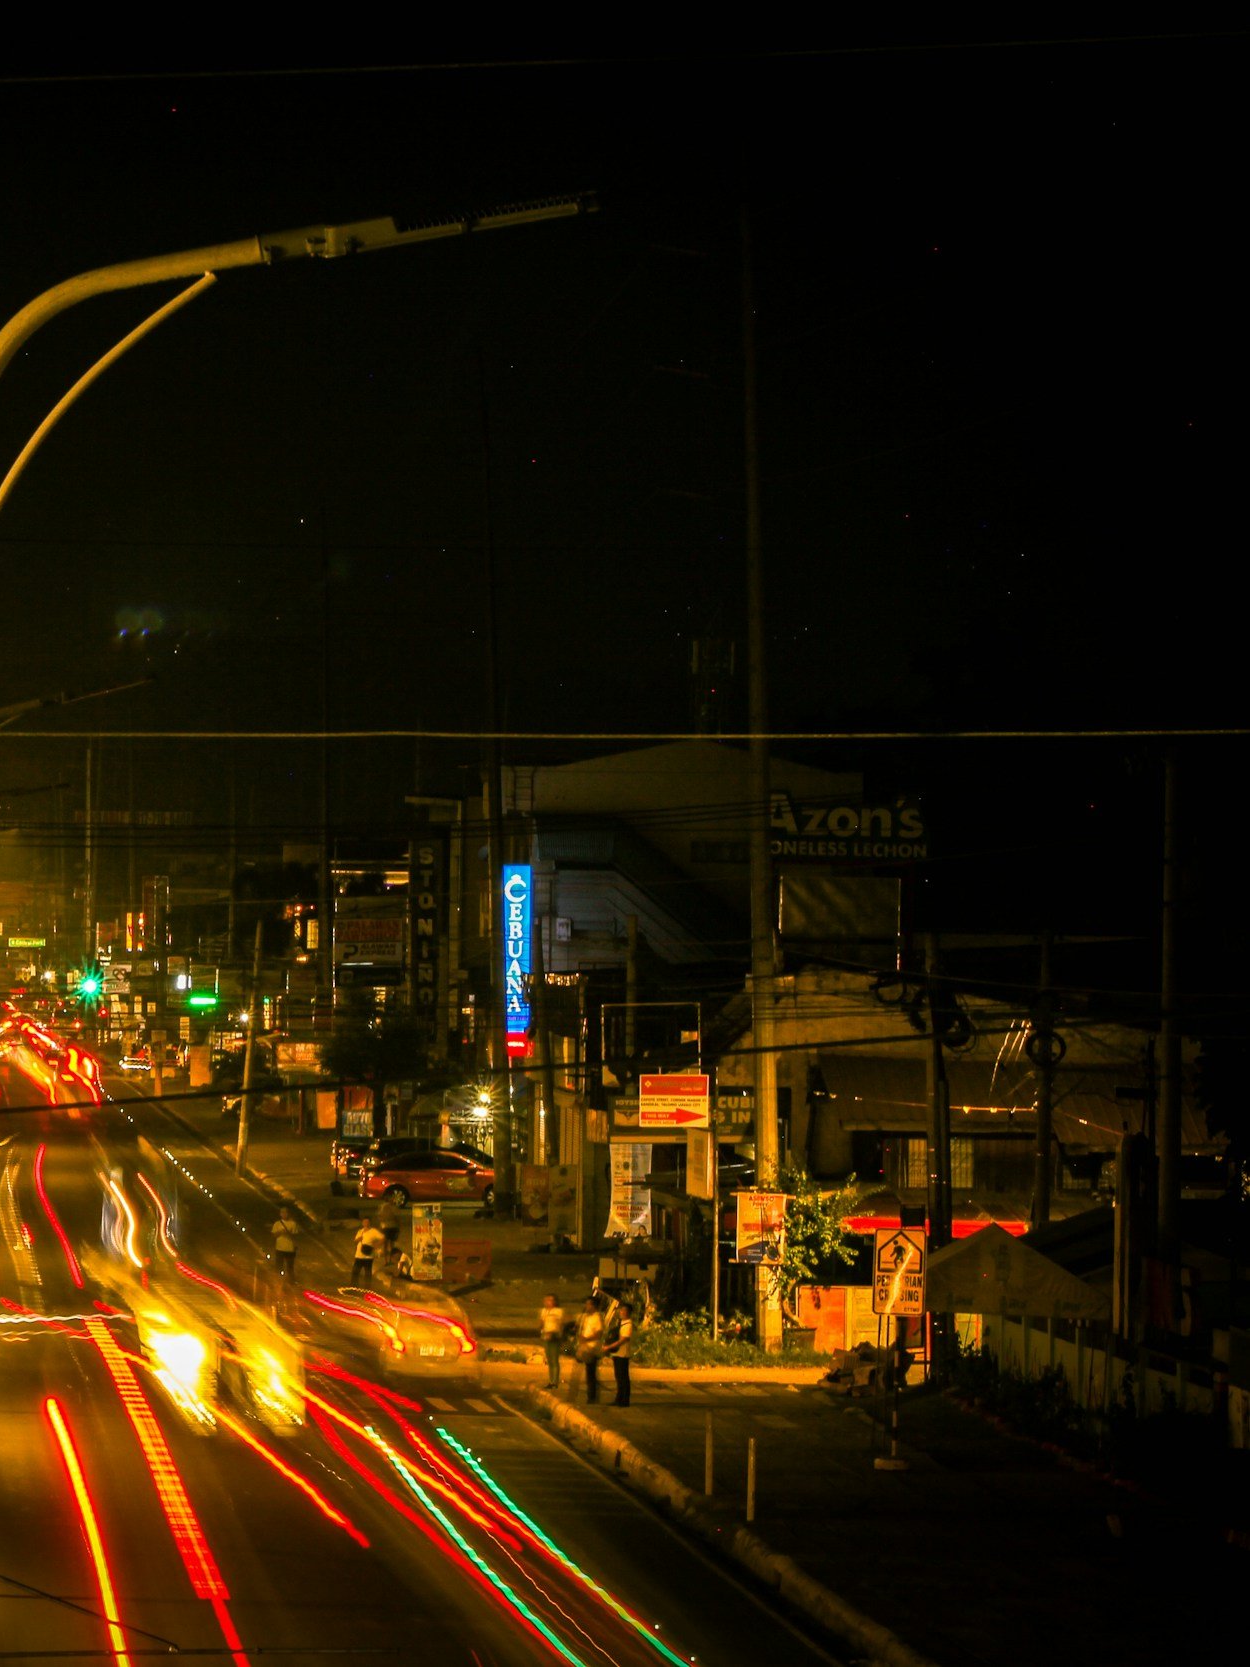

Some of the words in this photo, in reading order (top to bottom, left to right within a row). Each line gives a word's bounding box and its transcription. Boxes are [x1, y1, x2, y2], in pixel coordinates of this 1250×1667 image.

[769, 793, 925, 839] Azon's
[770, 840, 848, 857] ONELESS
[853, 842, 927, 859] LECHON
[504, 873, 527, 1013] CEBUANA
[876, 1274, 923, 1288] PEDRIAN
